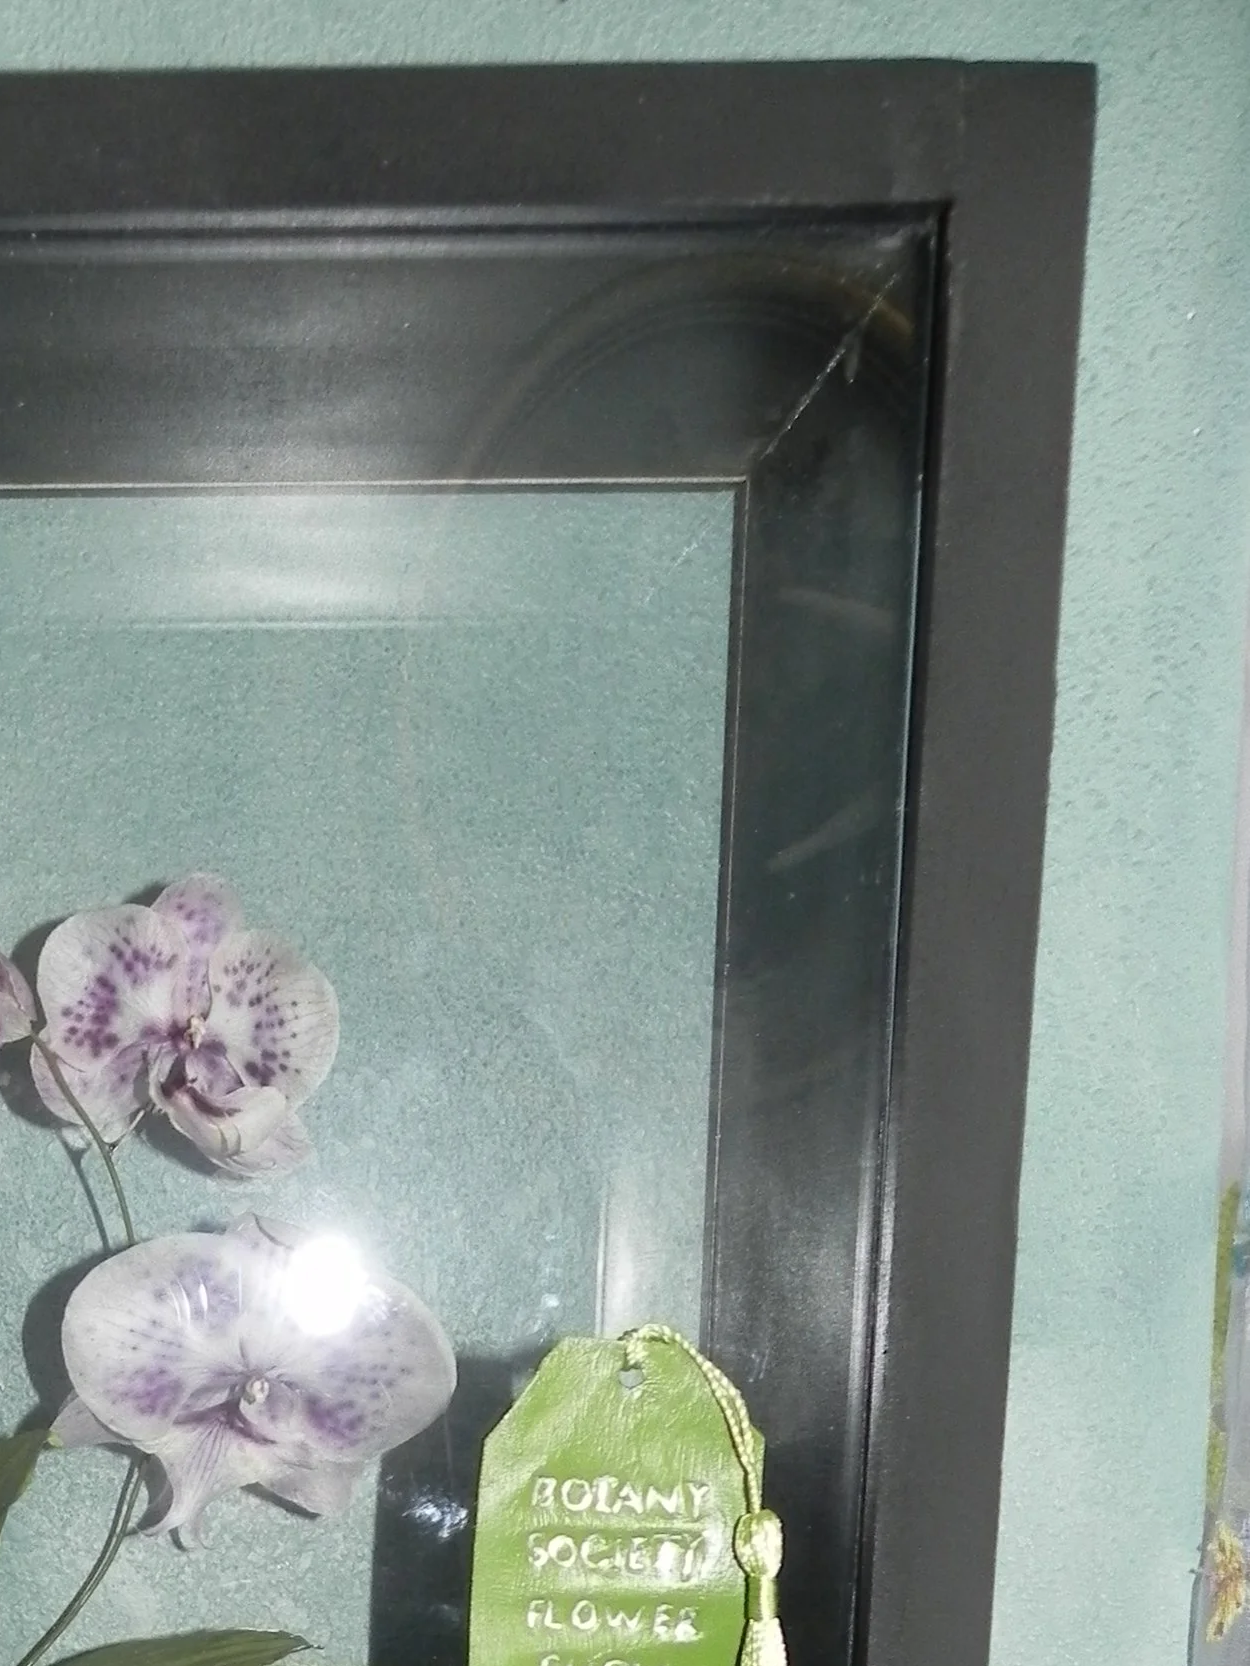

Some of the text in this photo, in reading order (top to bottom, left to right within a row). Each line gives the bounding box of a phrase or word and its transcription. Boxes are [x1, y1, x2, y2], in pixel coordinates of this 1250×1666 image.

[532, 1475, 710, 1517] BOTANY
[527, 1531, 710, 1581] SOCIETY
[526, 1600, 703, 1642] FLOWER
